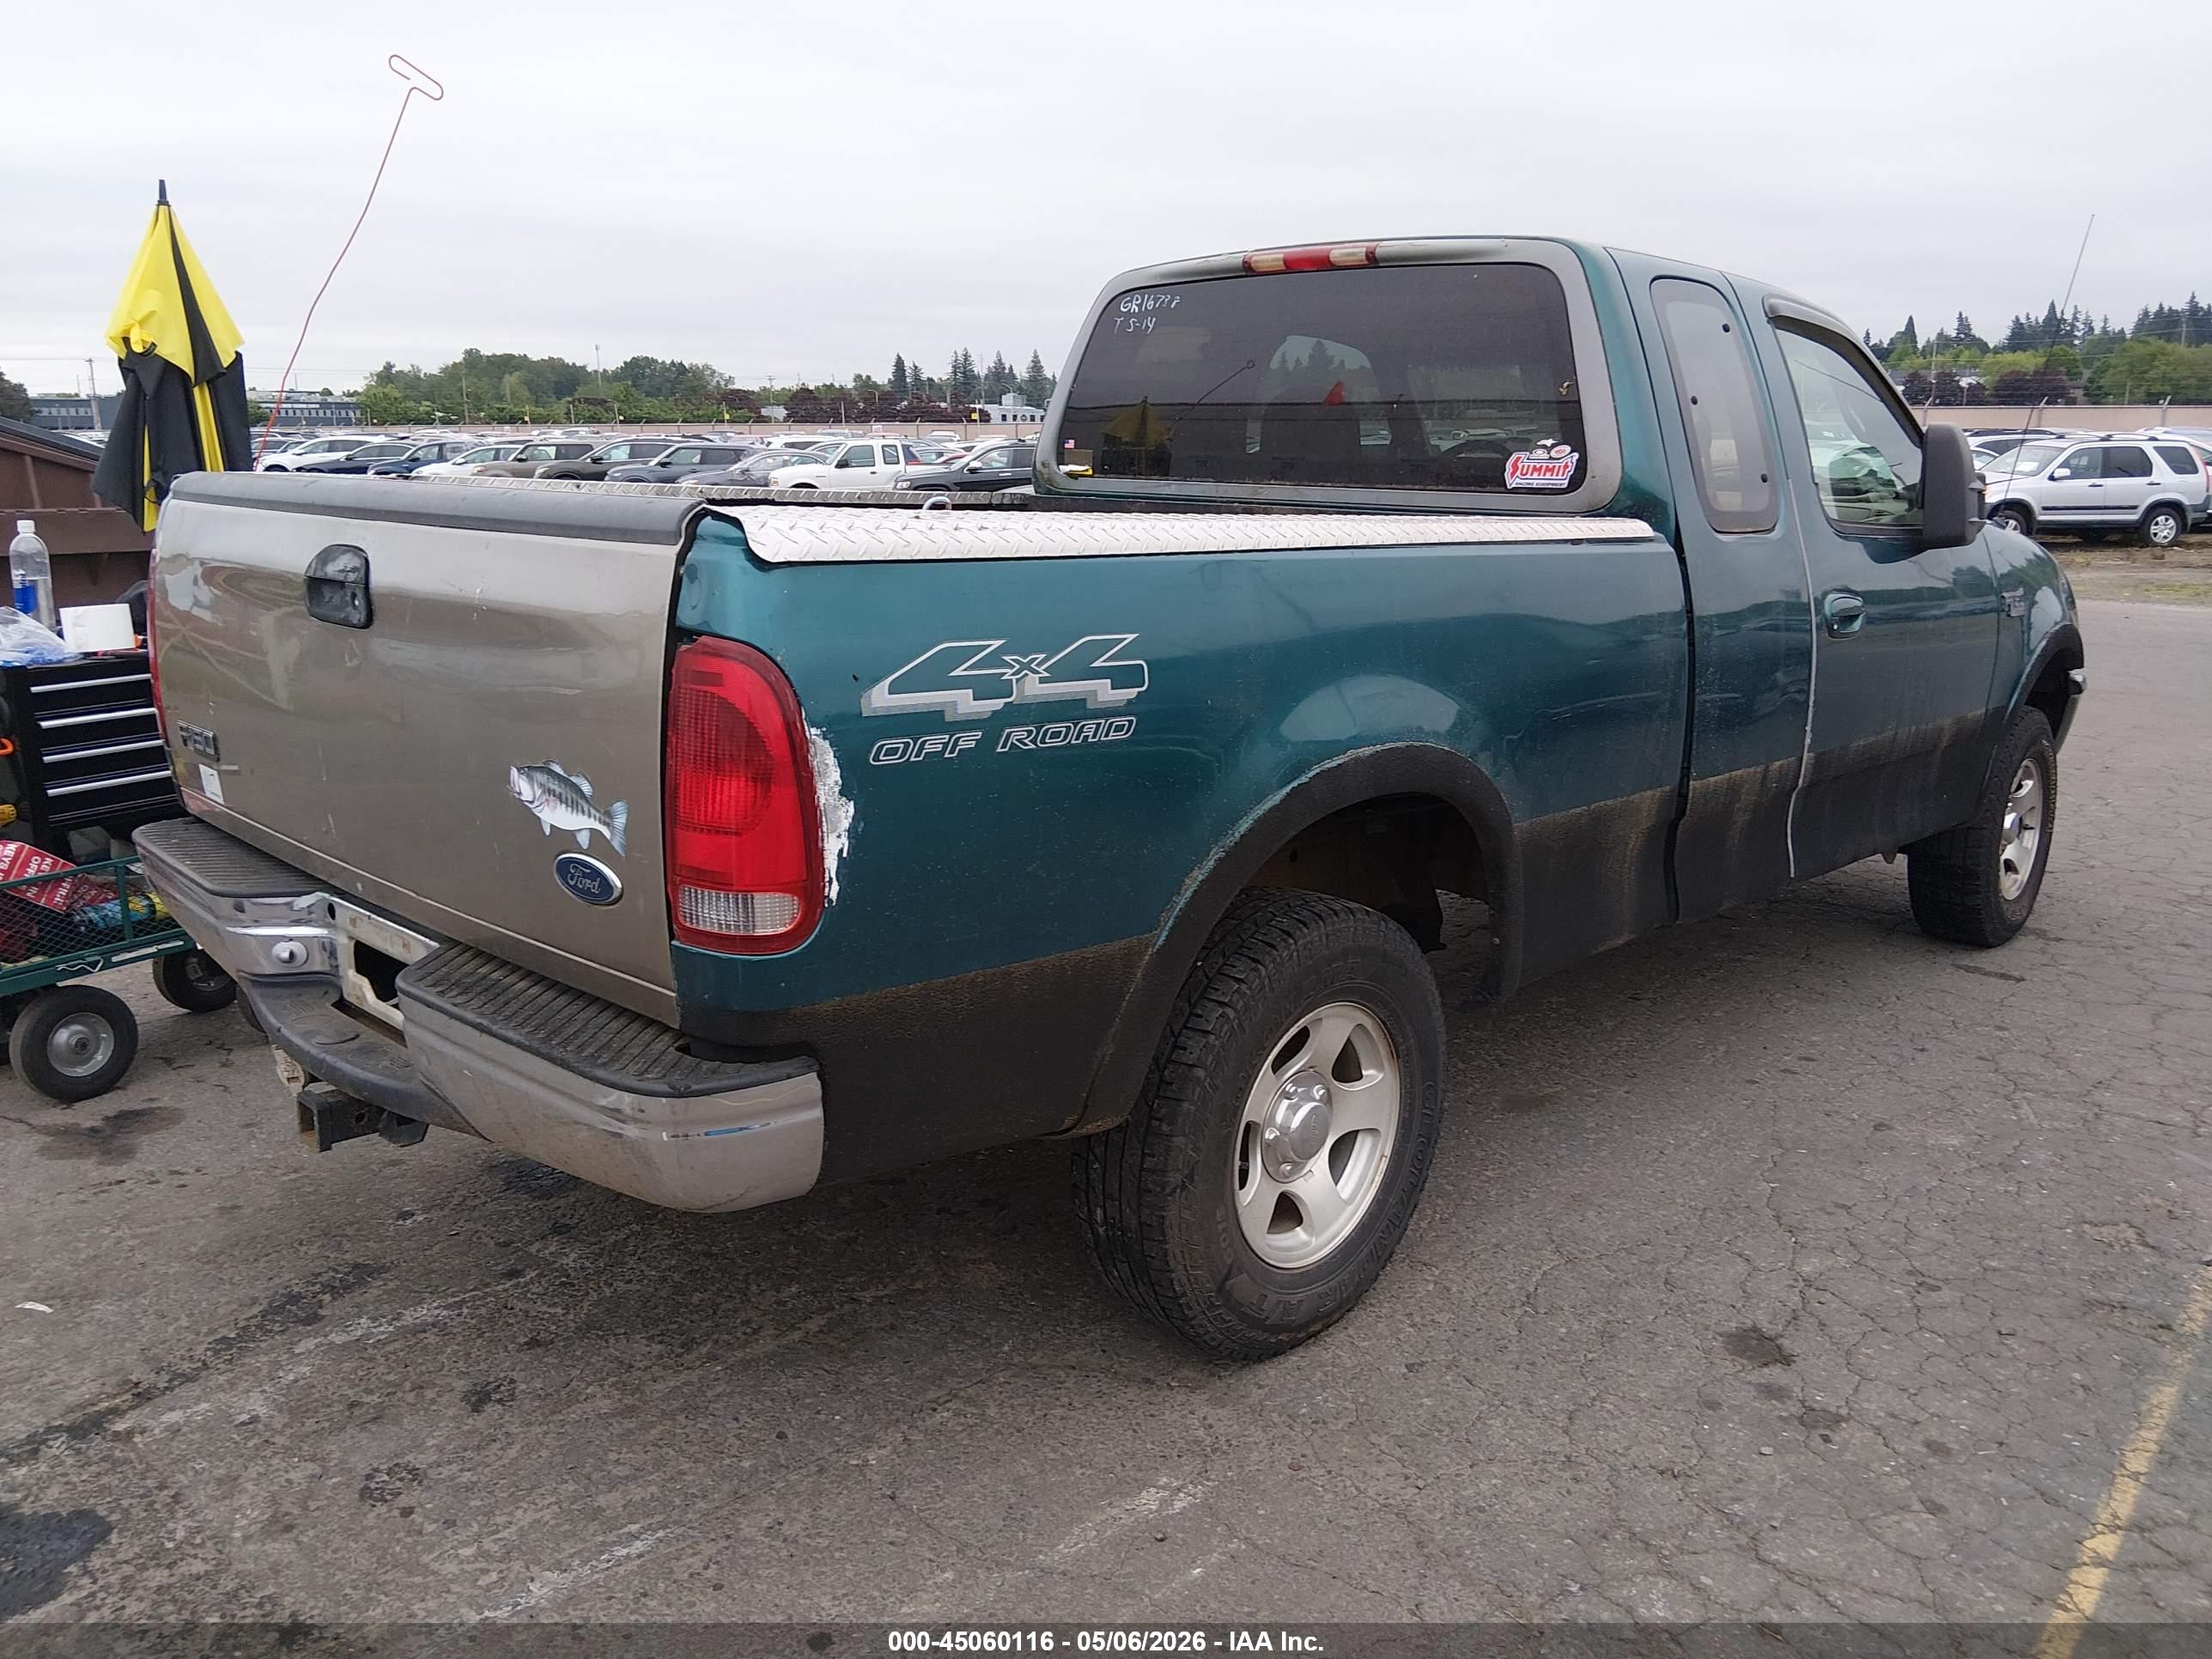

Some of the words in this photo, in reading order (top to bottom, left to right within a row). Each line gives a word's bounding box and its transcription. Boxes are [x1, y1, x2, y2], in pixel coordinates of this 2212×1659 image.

[869, 731, 982, 765] OFF
[996, 716, 1137, 752] ROAD
[567, 863, 601, 894] Ford
